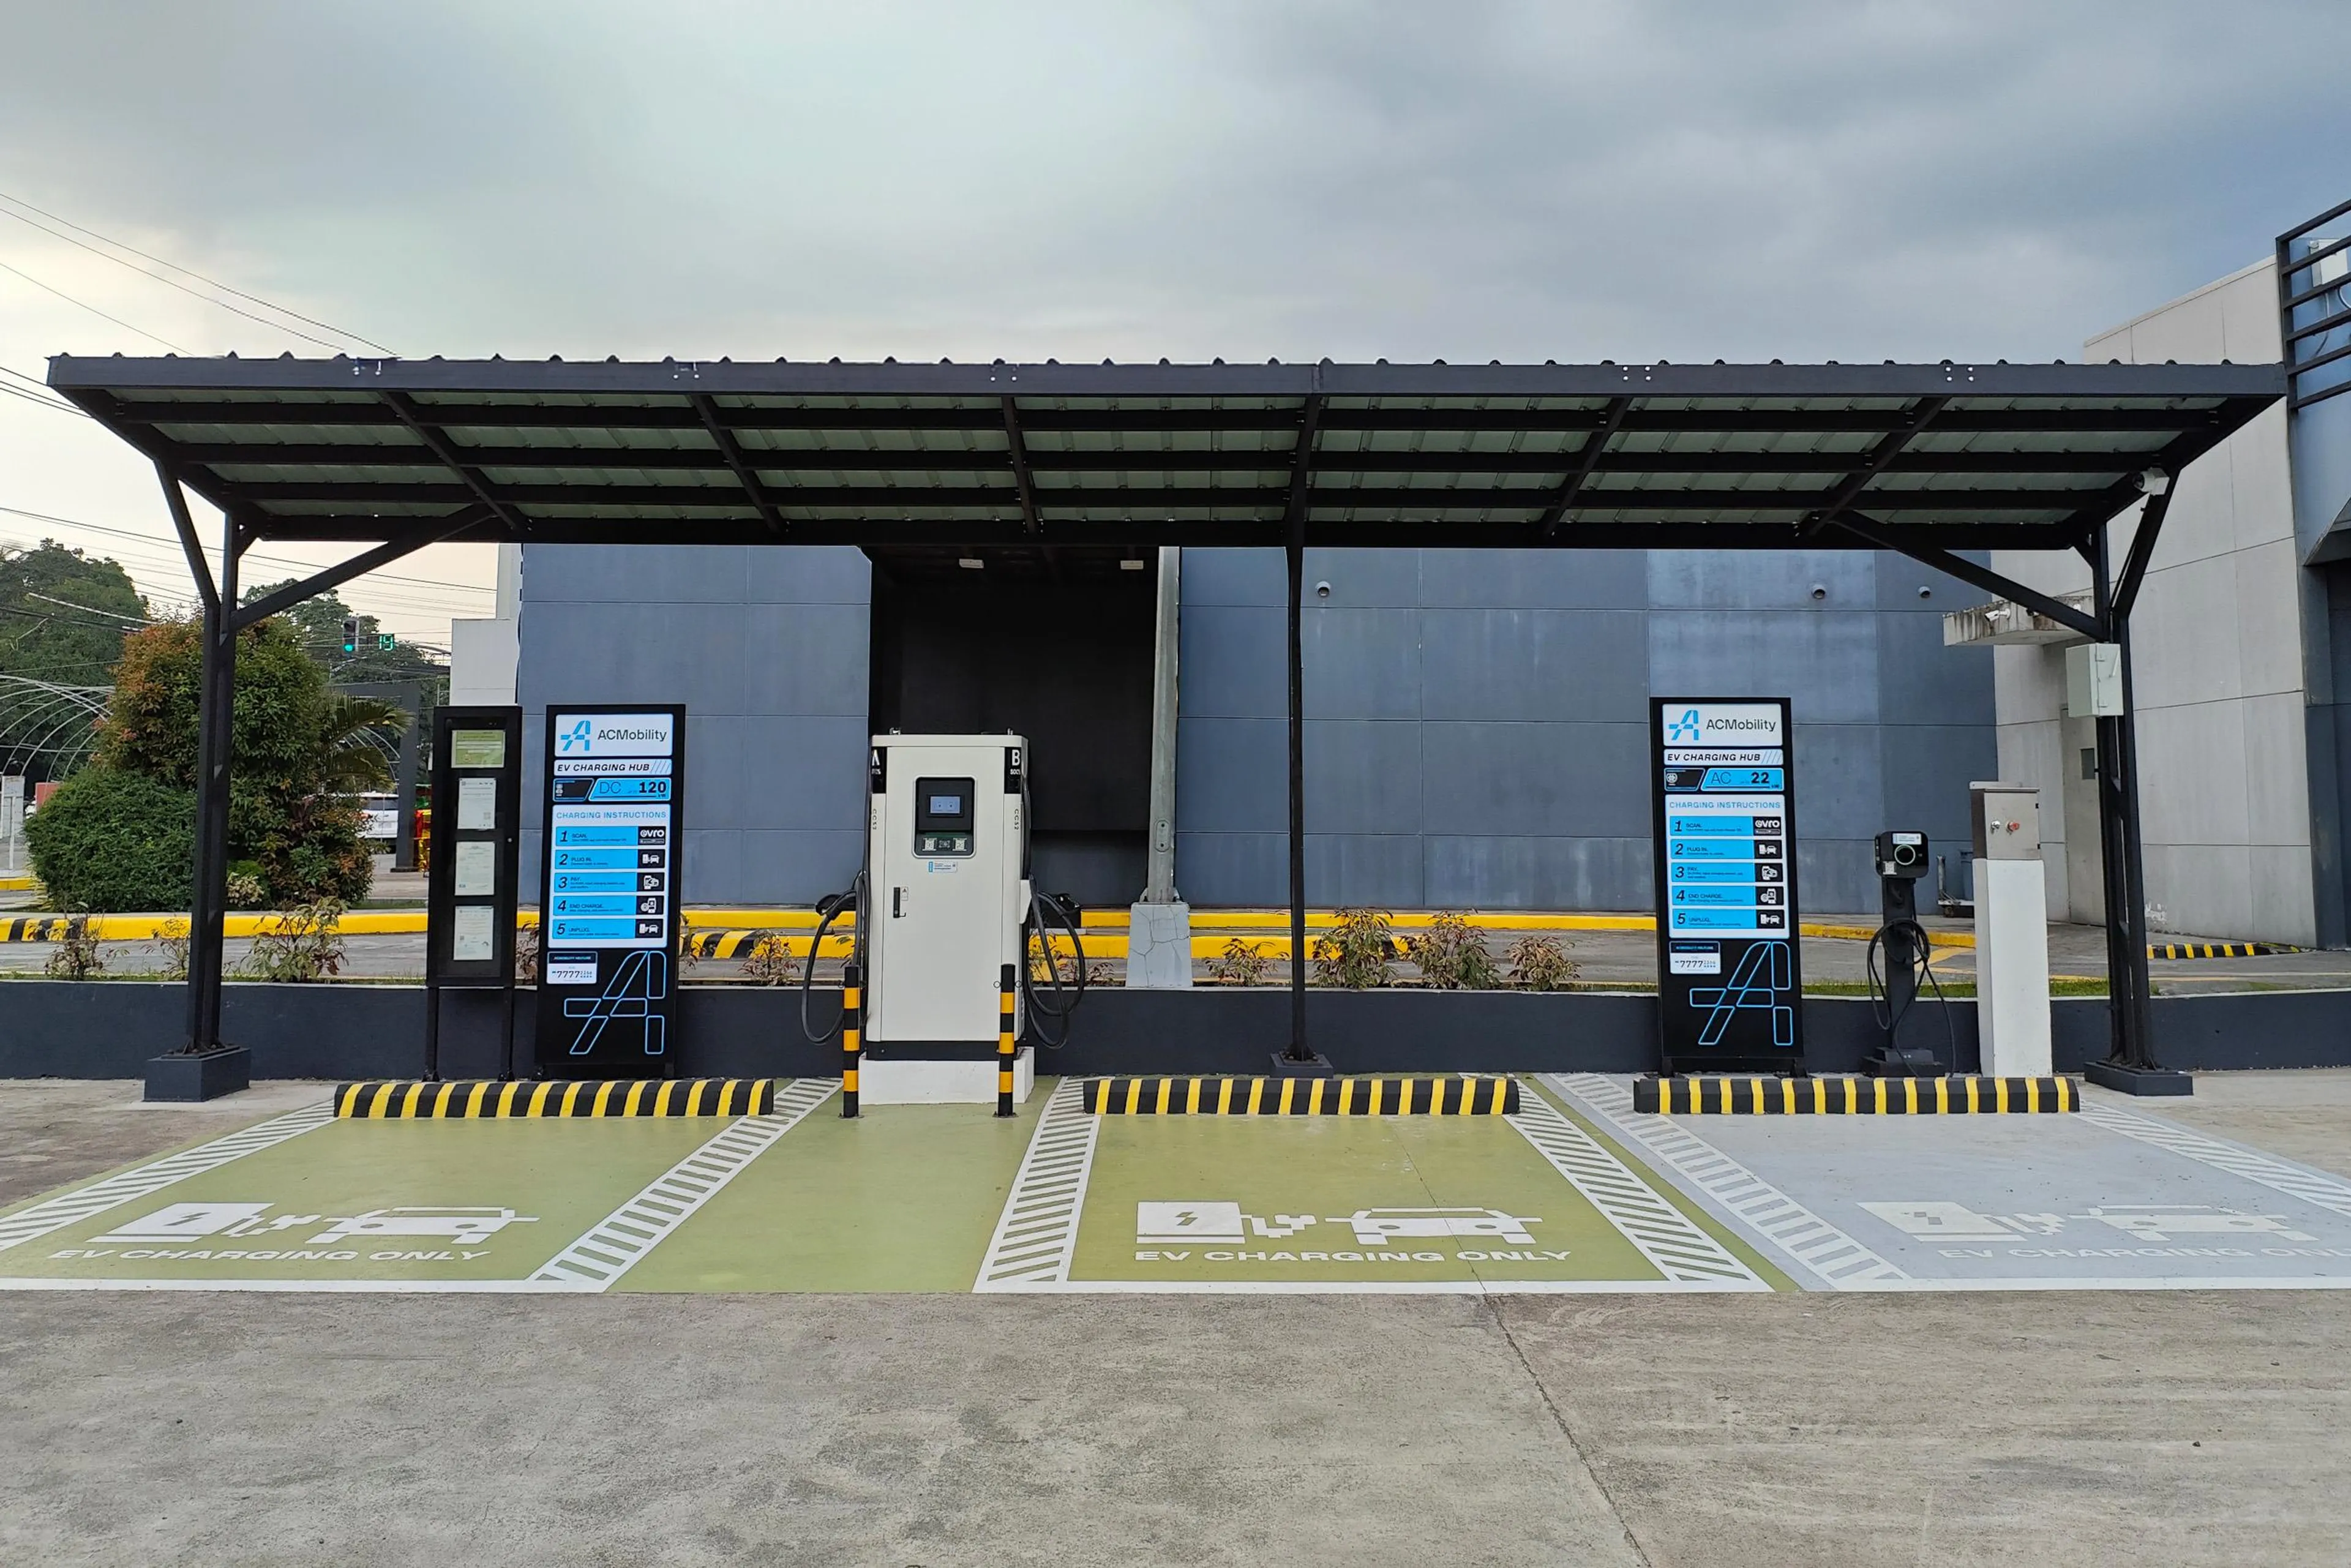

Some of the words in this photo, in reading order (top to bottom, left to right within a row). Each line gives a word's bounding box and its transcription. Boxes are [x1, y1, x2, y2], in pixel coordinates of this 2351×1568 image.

[379, 634, 393, 651] 19
[1706, 719, 1776, 732] ACMobility
[598, 729, 667, 742] ACMobility
[1012, 749, 1020, 766] B
[1711, 771, 1732, 784] AC
[1750, 771, 1770, 784] 22
[599, 781, 621, 793] DC
[639, 781, 667, 793] 120
[1674, 820, 1682, 832] 1
[560, 830, 568, 842] 1
[1674, 843, 1684, 855] 2
[559, 853, 568, 866] 2
[1675, 866, 1684, 878] 3
[558, 877, 568, 888] 3
[1676, 890, 1685, 901] 4
[558, 899, 567, 912] 4
[1677, 912, 1686, 925] 5
[557, 923, 566, 934] 5
[47, 1250, 117, 1259] EV
[119, 1250, 359, 1261] CHARGING
[368, 1250, 491, 1261] ONLY
[1134, 1251, 1191, 1261] EV
[1204, 1251, 1445, 1262] CHARGING
[1455, 1250, 1572, 1262] ONLY
[1938, 1249, 1993, 1258] EV
[2008, 1248, 2255, 1258] CHARGING
[2260, 1248, 2351, 1257] ONL
